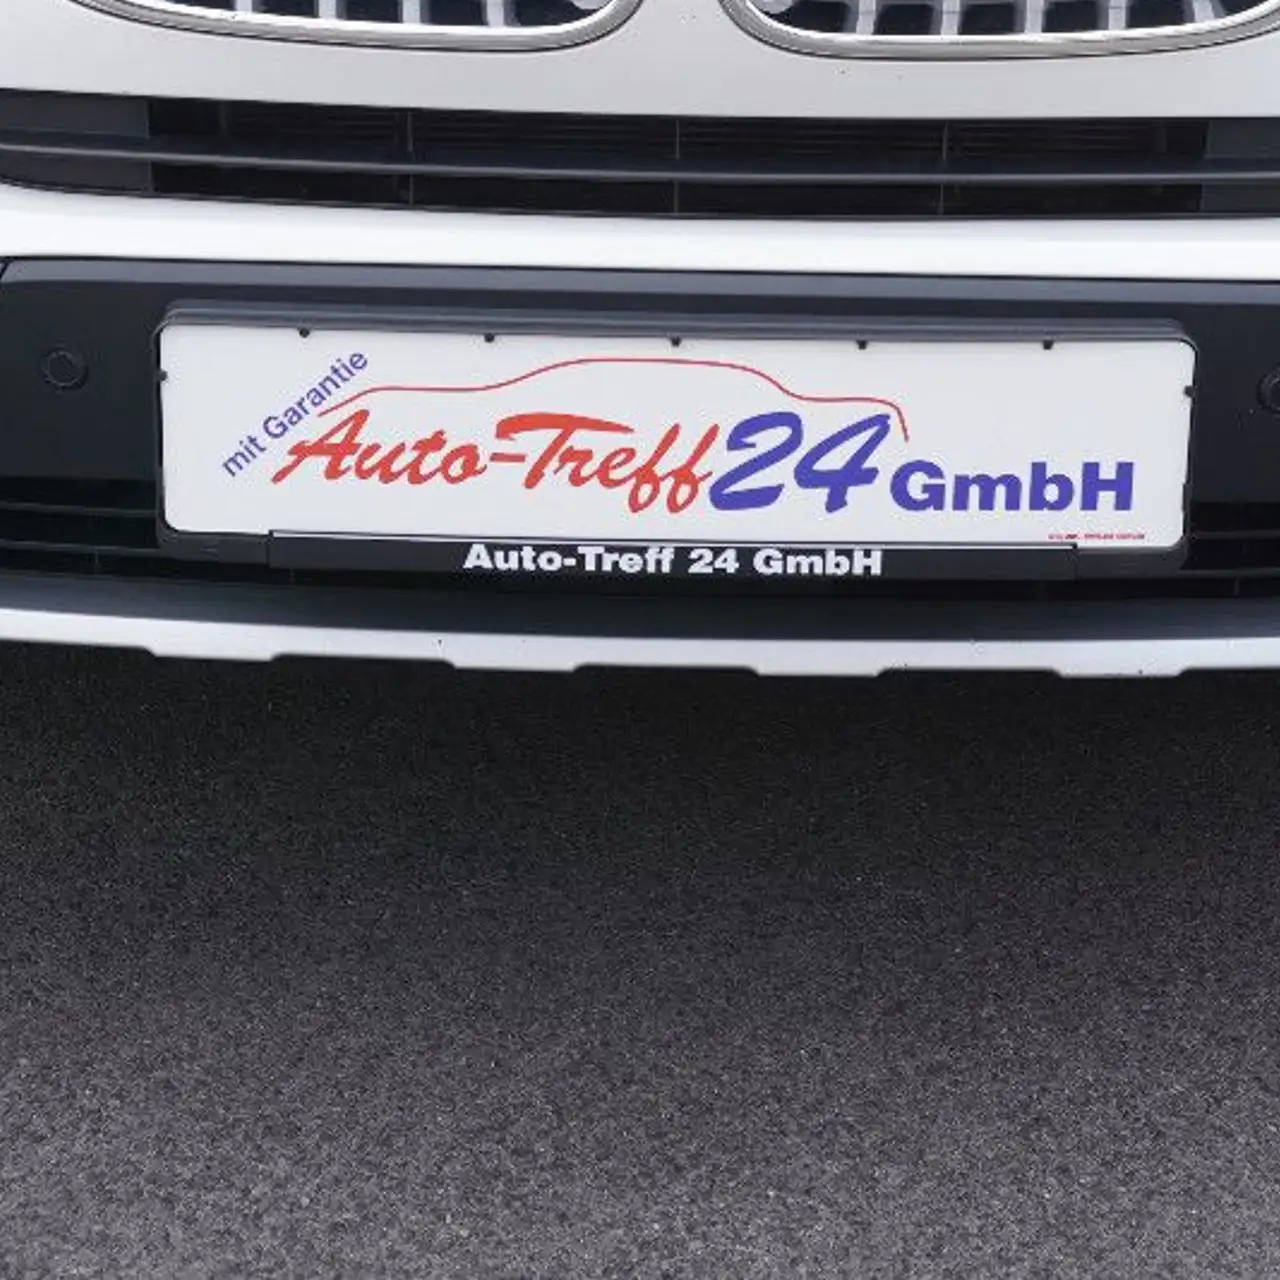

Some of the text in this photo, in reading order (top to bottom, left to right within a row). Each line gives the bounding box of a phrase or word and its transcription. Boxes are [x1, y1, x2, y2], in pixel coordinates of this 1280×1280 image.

[222, 351, 369, 478] mit Garantie
[890, 459, 1135, 513] GmbH
[462, 543, 883, 577] Auto-Treff 24 GmbH
